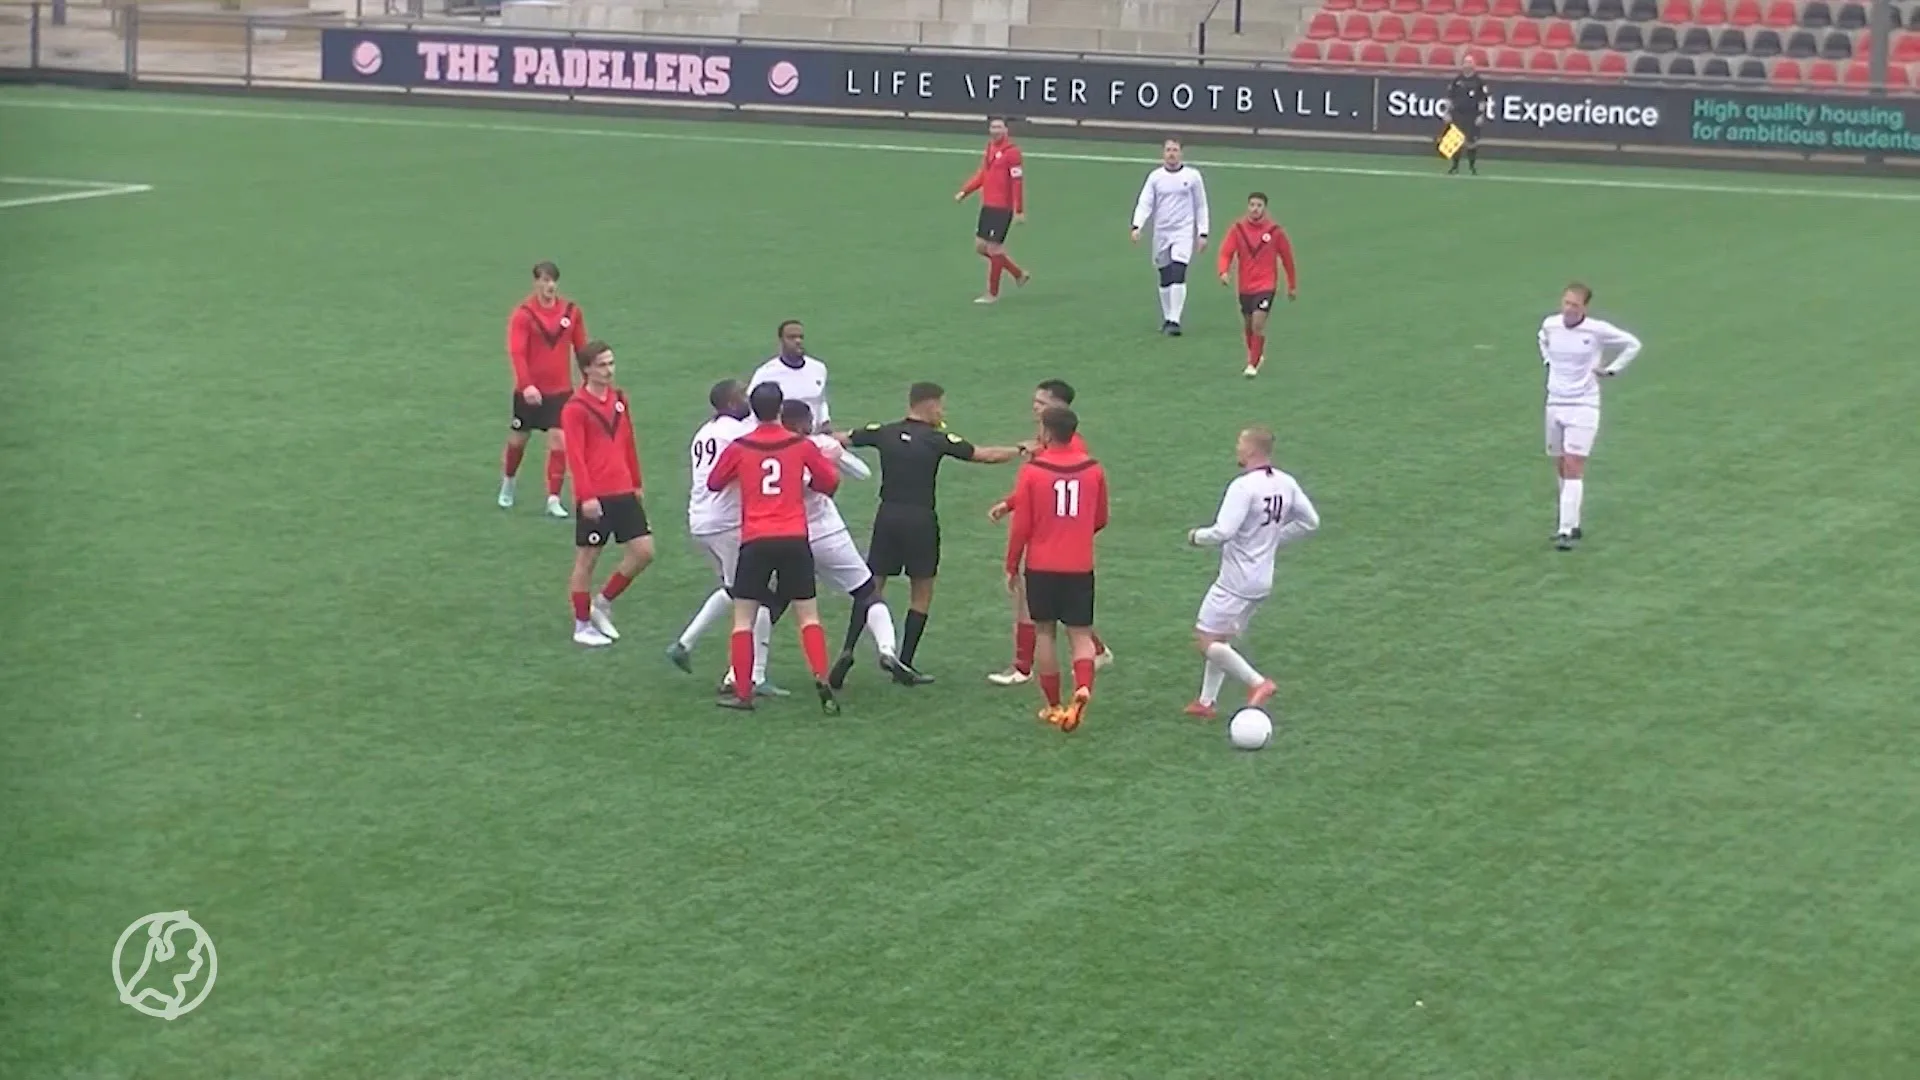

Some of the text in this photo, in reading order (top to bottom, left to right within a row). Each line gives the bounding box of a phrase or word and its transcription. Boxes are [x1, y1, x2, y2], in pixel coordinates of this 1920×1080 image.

[418, 41, 731, 95] THE PADELLERS
[846, 69, 934, 98] LIFE
[1502, 95, 1660, 128] Experience
[1693, 99, 1905, 131] High quality housing
[1692, 122, 1920, 150] for ambitious students
[693, 436, 718, 468] 99
[761, 457, 783, 496] 2
[1052, 478, 1081, 518] 11
[1261, 494, 1284, 527] 34
